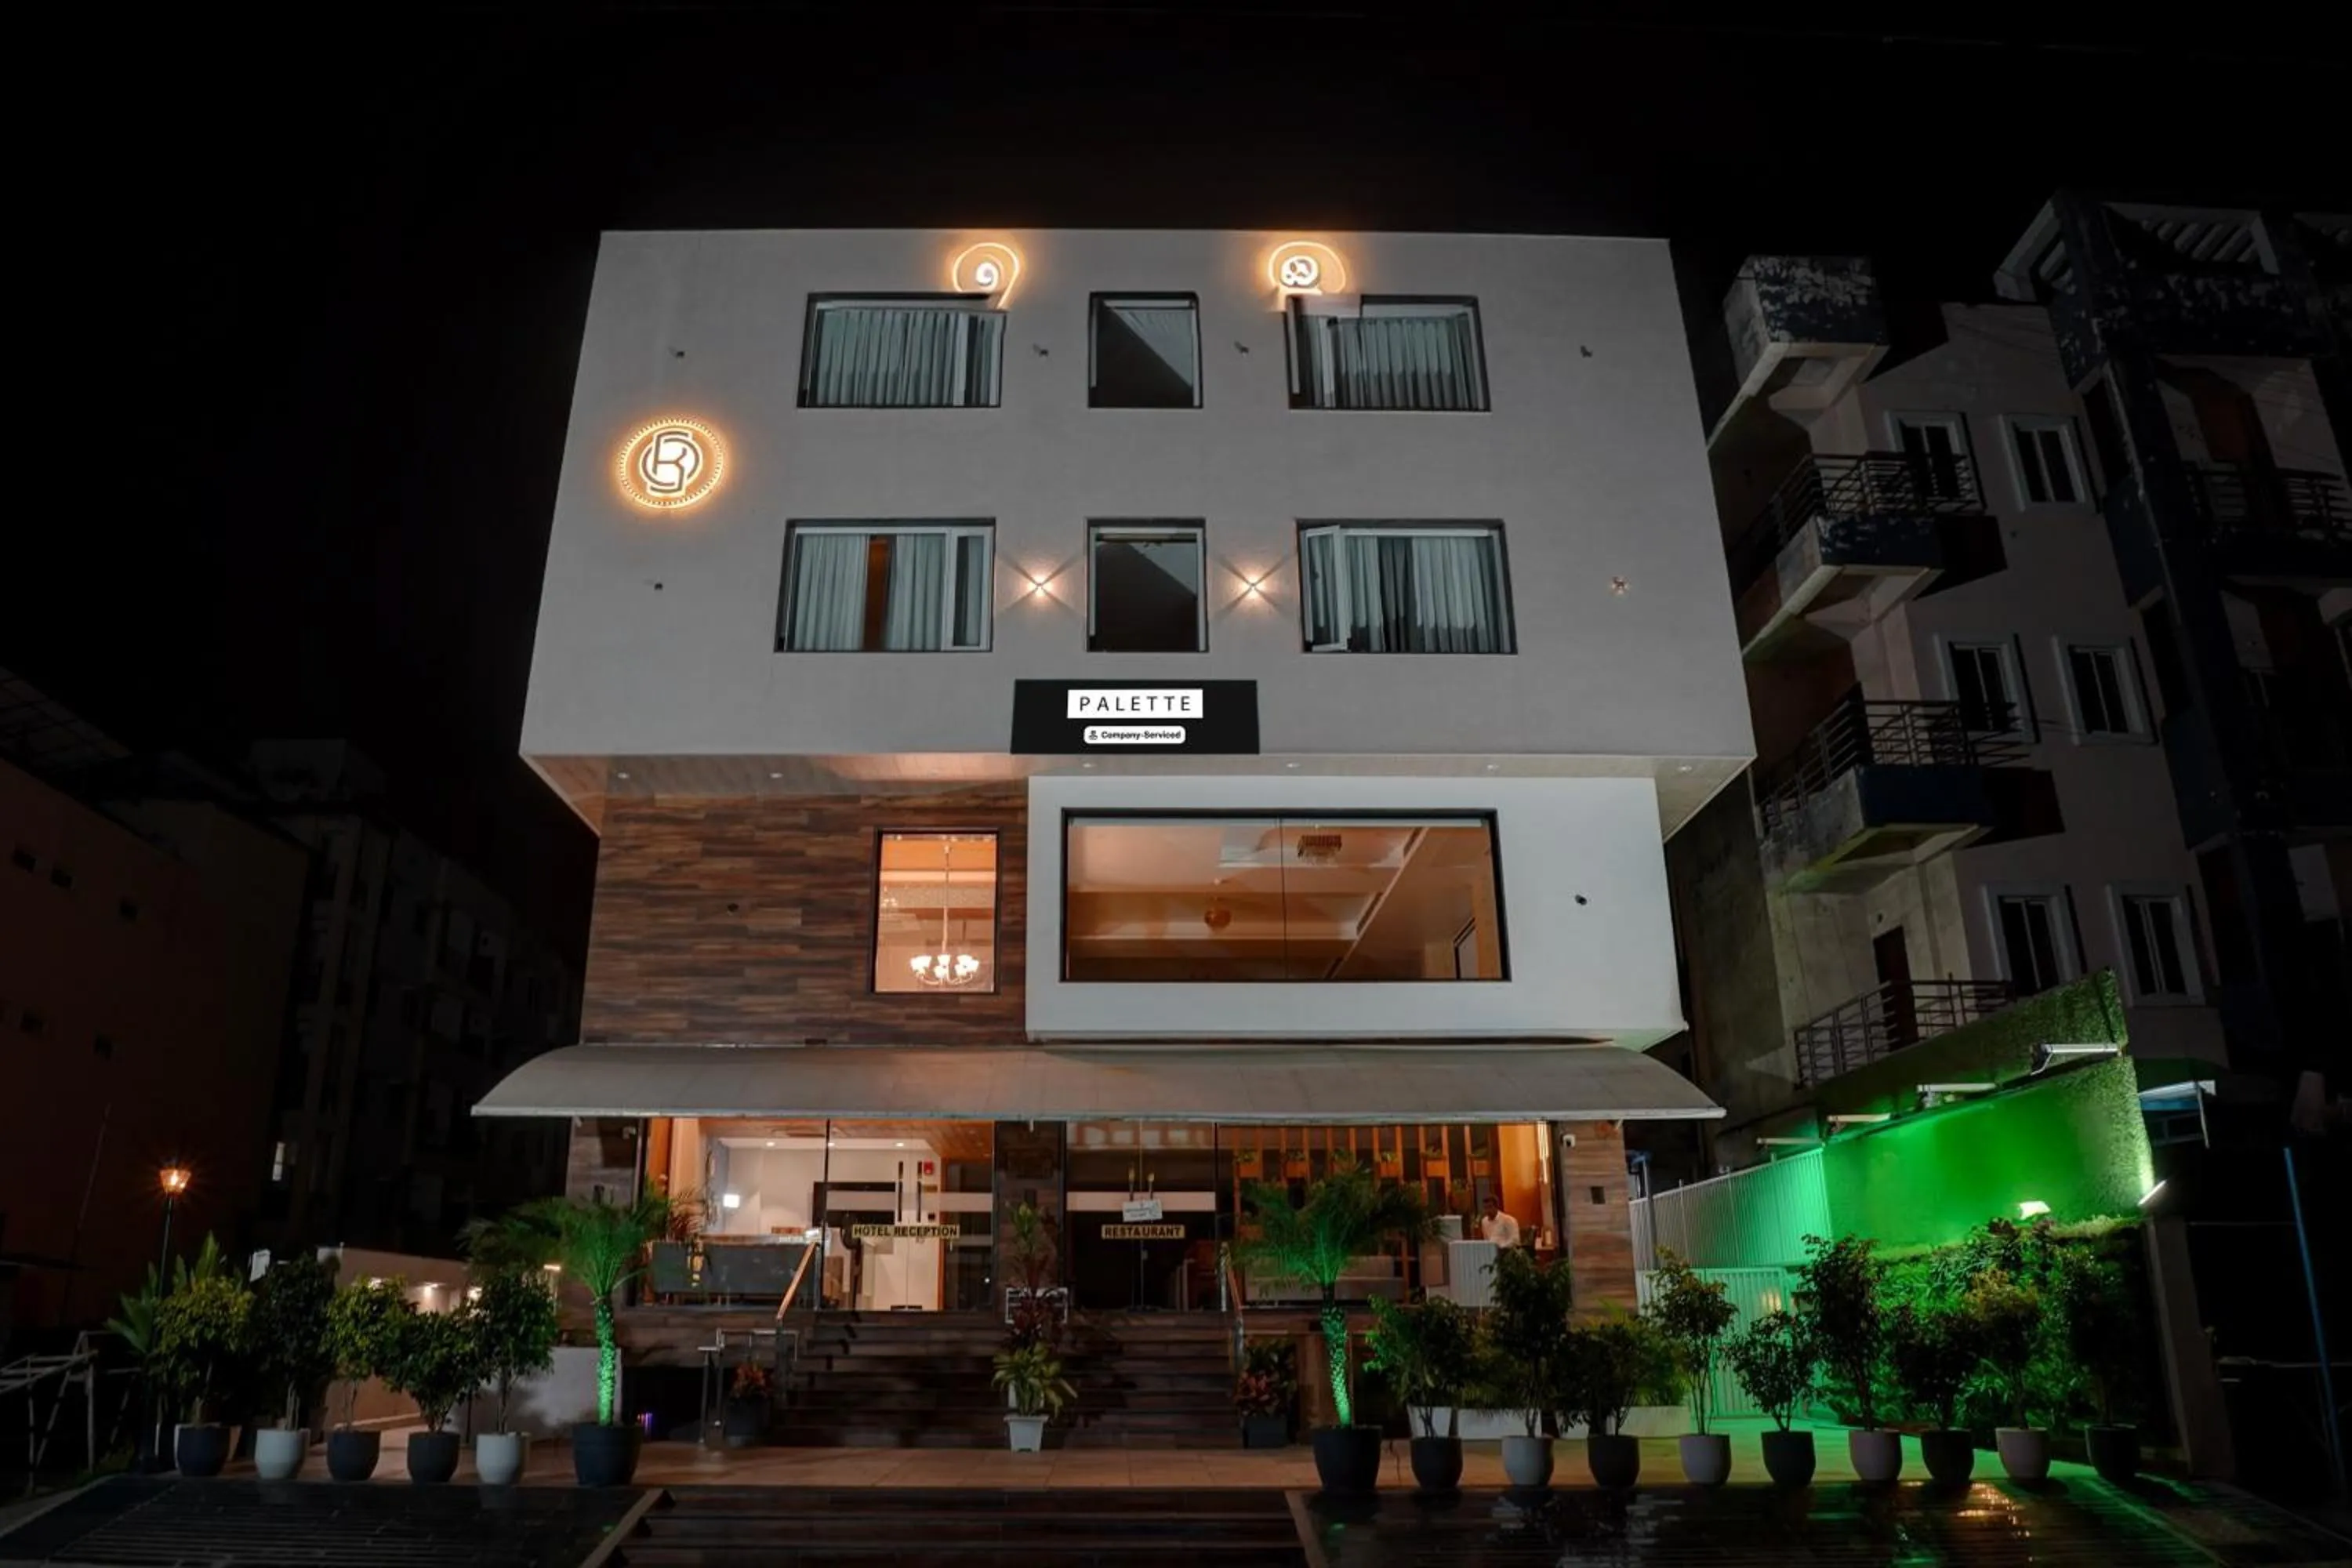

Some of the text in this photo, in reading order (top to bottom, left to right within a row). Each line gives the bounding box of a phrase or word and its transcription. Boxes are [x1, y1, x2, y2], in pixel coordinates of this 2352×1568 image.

[1080, 696, 1191, 711] PALETTE
[1101, 731, 1181, 740] Company-Serviced
[854, 1225, 957, 1236] HOTEL RECEPTION
[1105, 1227, 1181, 1236] RESTAURANT
